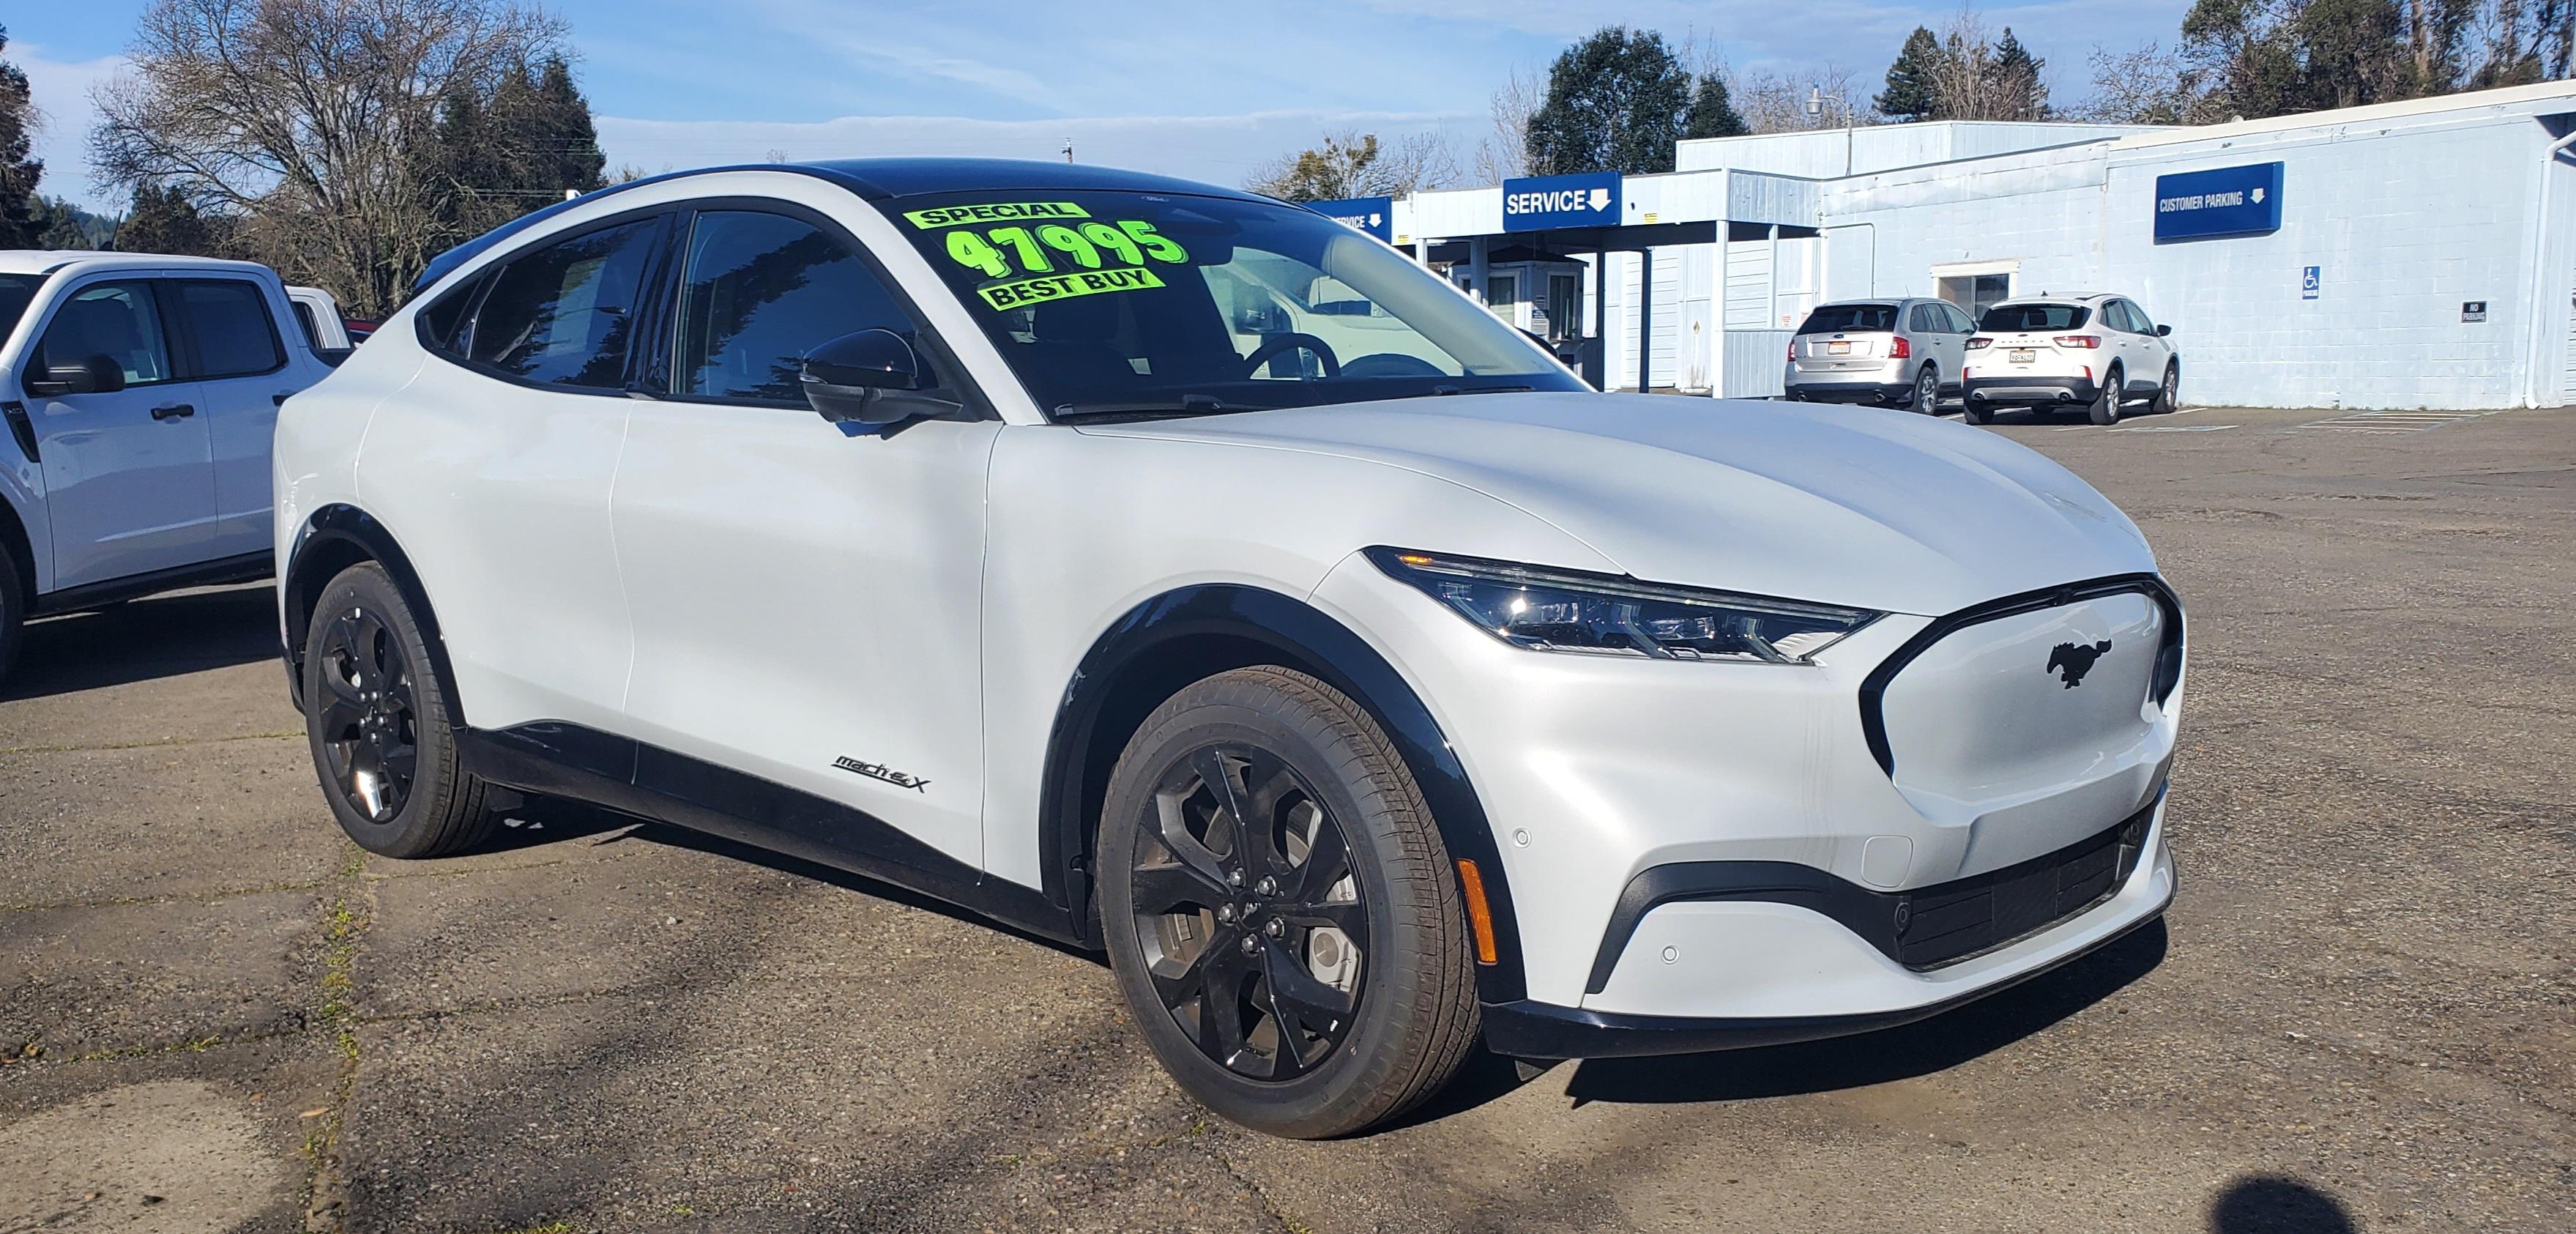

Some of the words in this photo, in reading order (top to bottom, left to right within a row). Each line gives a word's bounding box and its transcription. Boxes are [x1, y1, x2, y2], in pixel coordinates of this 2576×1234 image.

[1506, 190, 1586, 215] SERVICE
[2159, 196, 2203, 212] CUSTOMER
[2205, 191, 2243, 208] PARKING
[920, 203, 1077, 225] SPECIAL
[946, 220, 1189, 279] 47995
[986, 278, 1078, 308] BEST
[1084, 269, 1150, 291] BUY
[2469, 303, 2479, 312] NO
